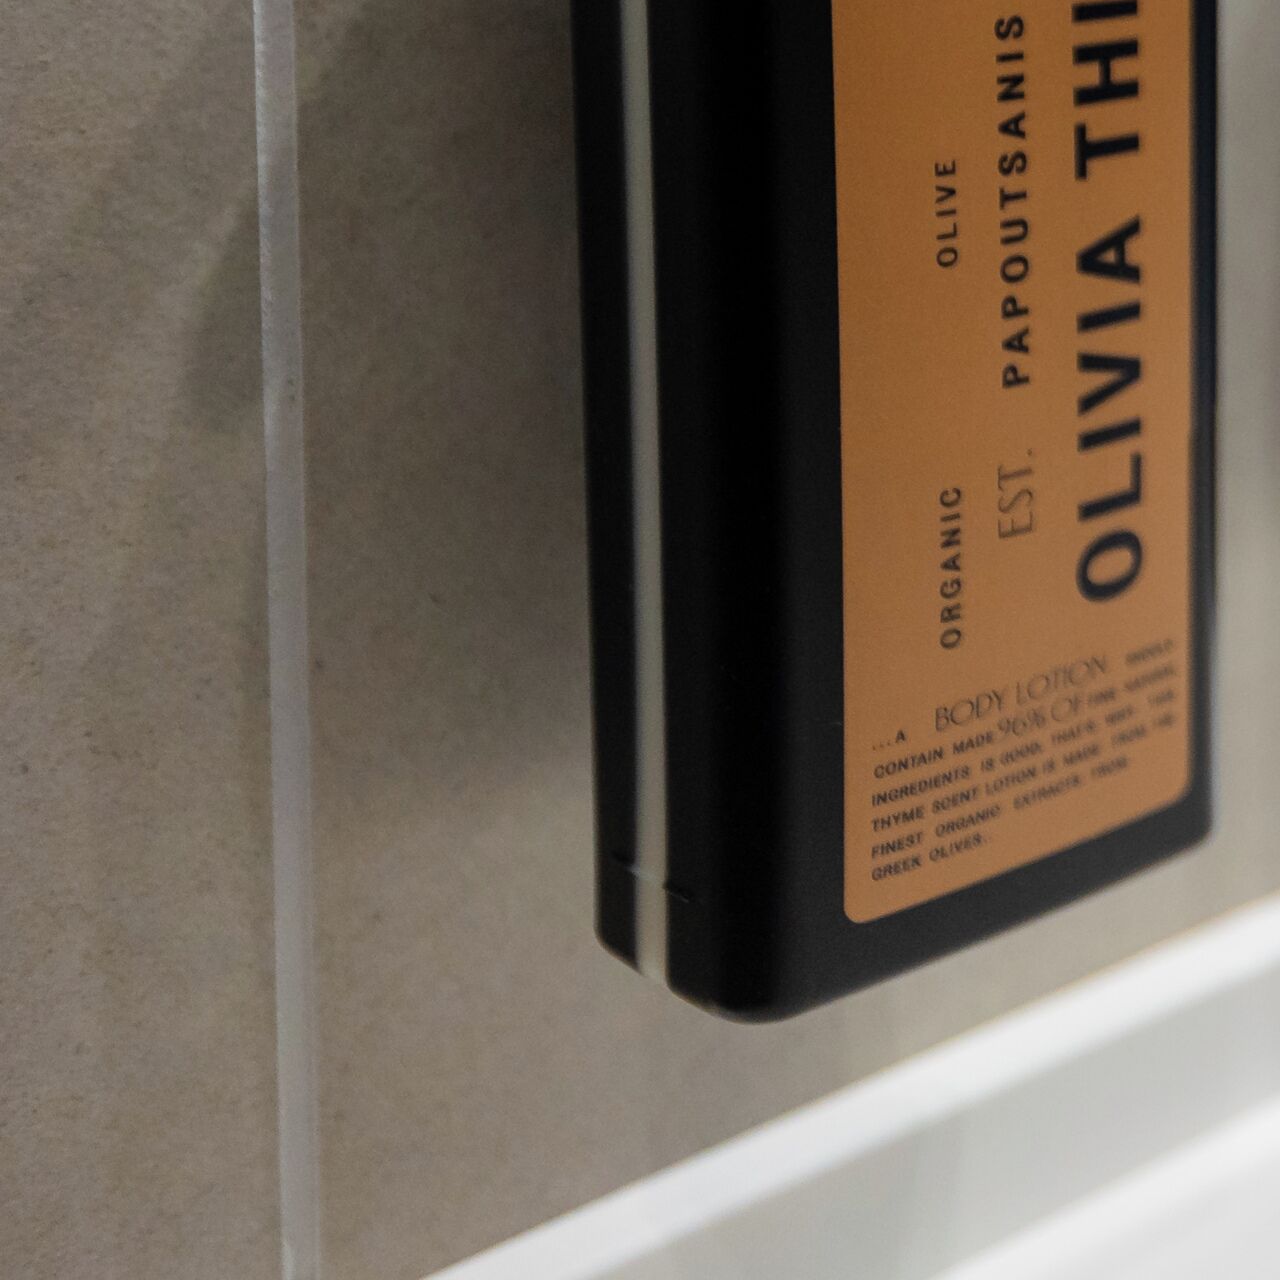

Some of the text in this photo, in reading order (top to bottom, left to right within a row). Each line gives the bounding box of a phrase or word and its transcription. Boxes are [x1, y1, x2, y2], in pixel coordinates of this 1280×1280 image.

[935, 159, 958, 268] OLIVE
[994, 14, 1031, 389] PAPOUTSANIS
[1076, 214, 1142, 602] OLIVIA
[997, 448, 1033, 539] EST.
[940, 487, 962, 650] ORGANIC
[873, 746, 944, 779] CONTAIN
[952, 732, 993, 754] MADE
[1051, 694, 1081, 722] OF
[935, 689, 1006, 733] BODY
[1016, 655, 1108, 705] LOTION
[871, 765, 971, 807] INGREDIENTS
[980, 758, 996, 772] IS
[872, 805, 925, 832] THYME
[932, 786, 978, 813] SCENT
[985, 767, 1037, 795] LOTION
[871, 831, 923, 859] FINEST
[935, 805, 1001, 838] ORGANIC
[871, 855, 922, 882] GREEK
